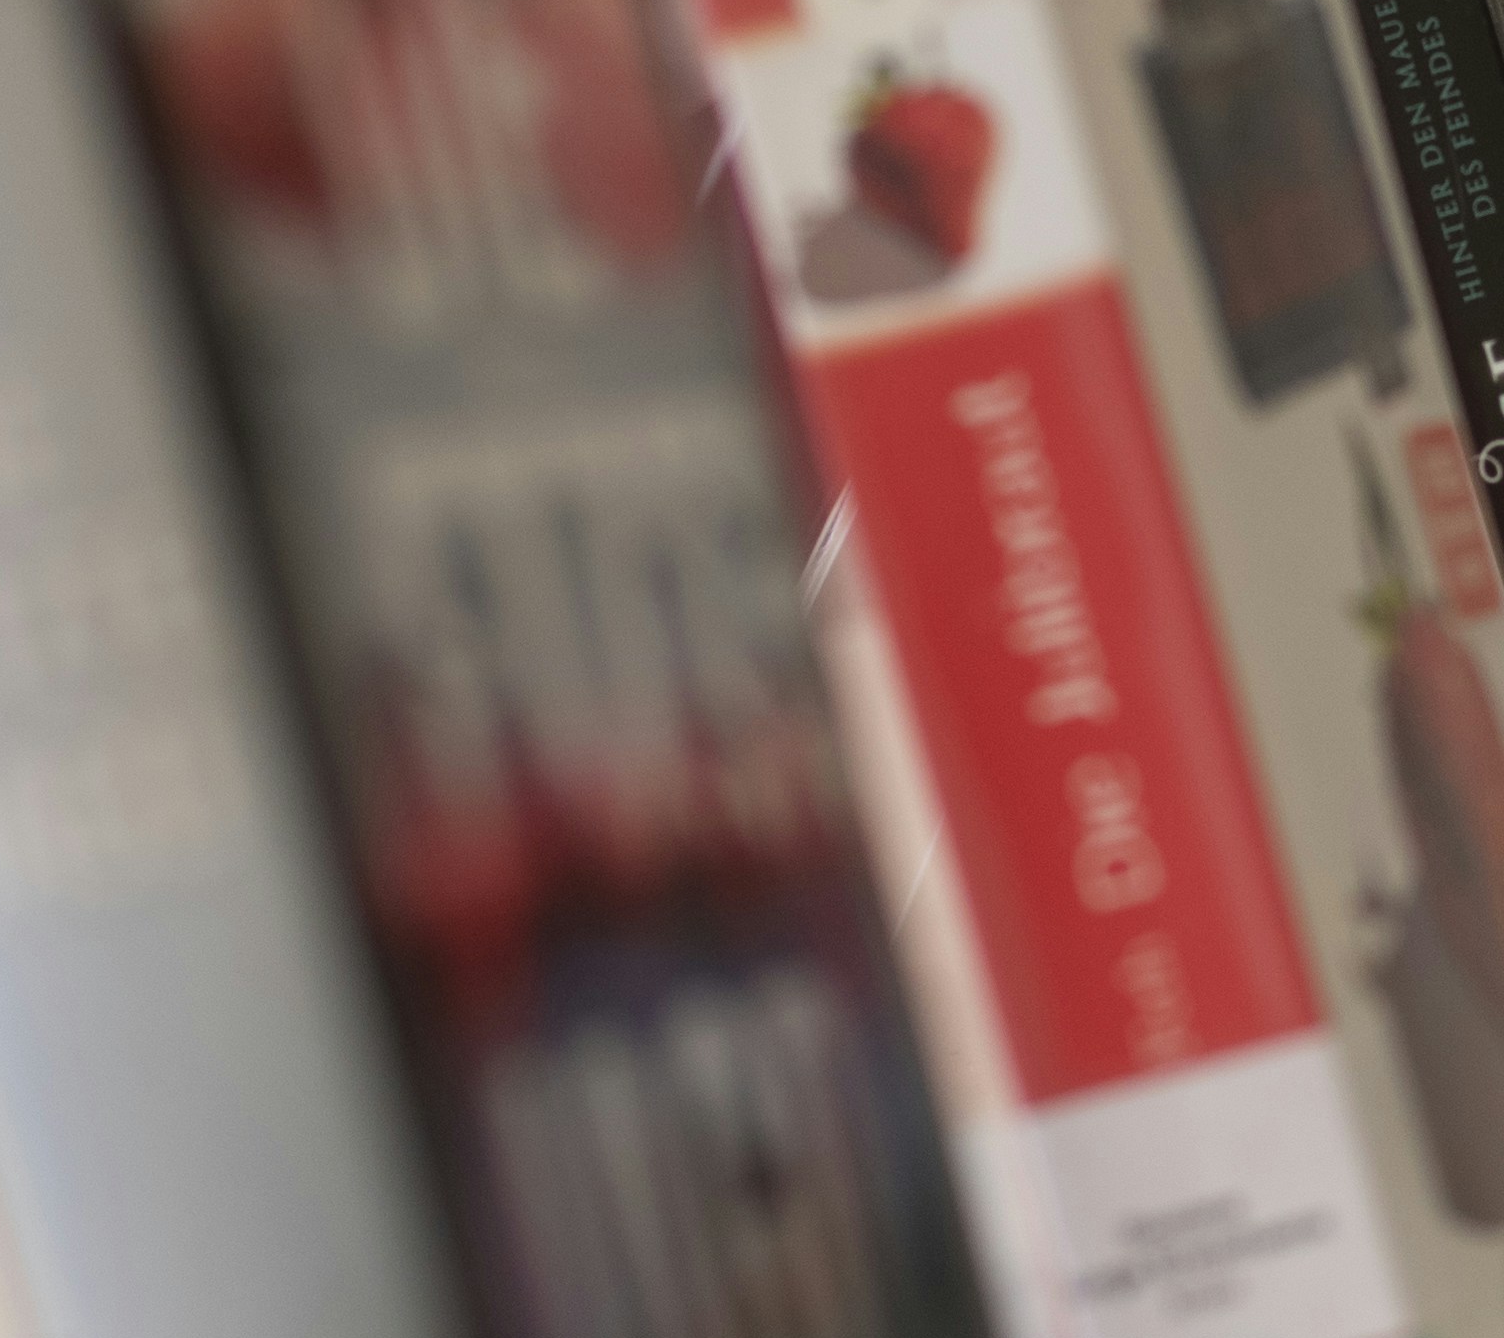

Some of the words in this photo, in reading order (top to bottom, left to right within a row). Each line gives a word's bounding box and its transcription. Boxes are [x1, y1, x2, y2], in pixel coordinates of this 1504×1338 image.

[1415, 16, 1476, 150] FEINDES
[1404, 102, 1444, 169] DEN
[1459, 158, 1496, 219] DES
[1430, 179, 1486, 303] HINTER
